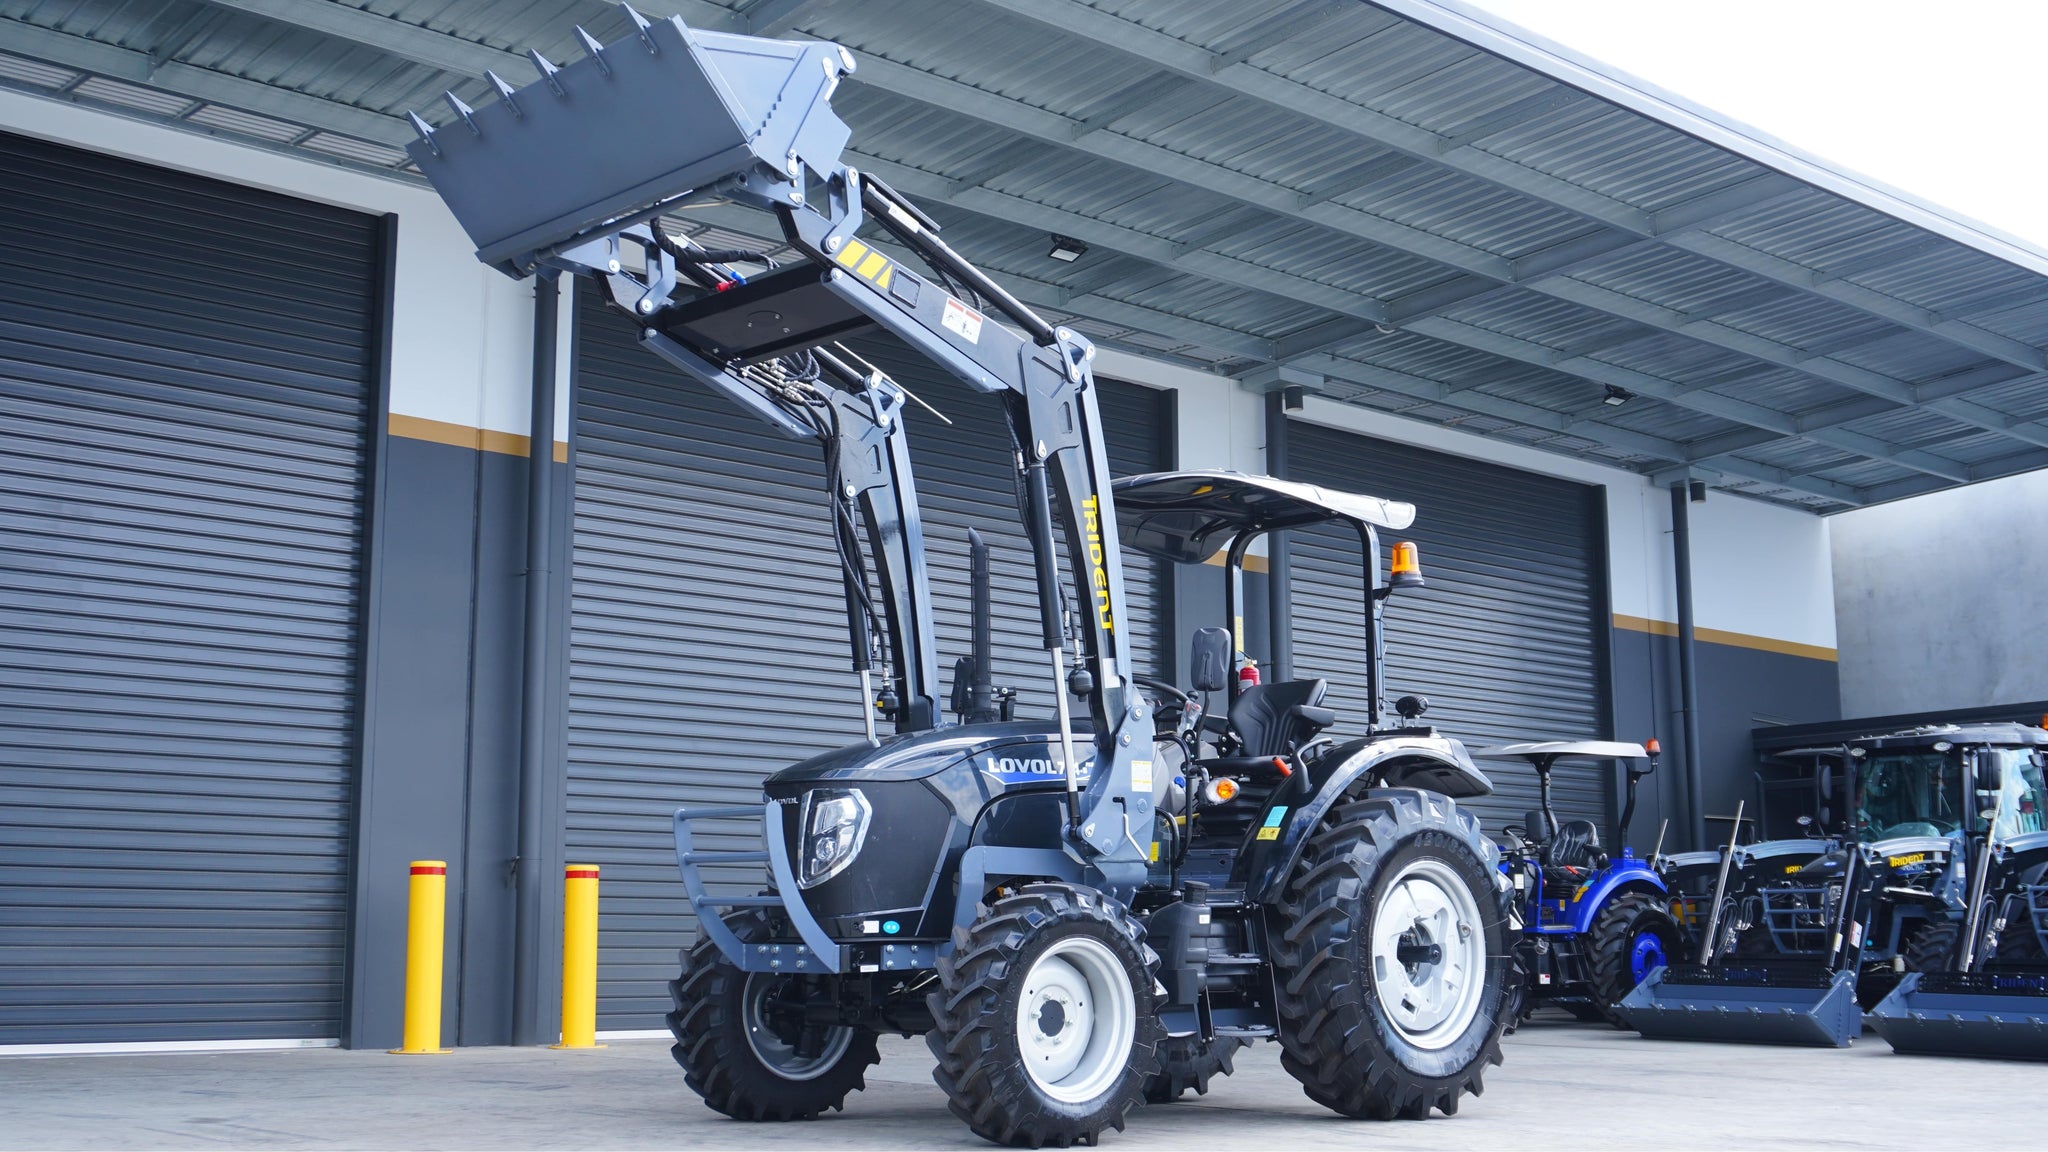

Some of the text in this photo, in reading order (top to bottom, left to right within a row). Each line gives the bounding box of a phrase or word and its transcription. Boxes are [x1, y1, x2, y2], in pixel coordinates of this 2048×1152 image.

[1082, 495, 1114, 635] TRIDENT
[987, 757, 1057, 775] LOVOL
[1888, 853, 1925, 867] TRIDENT
